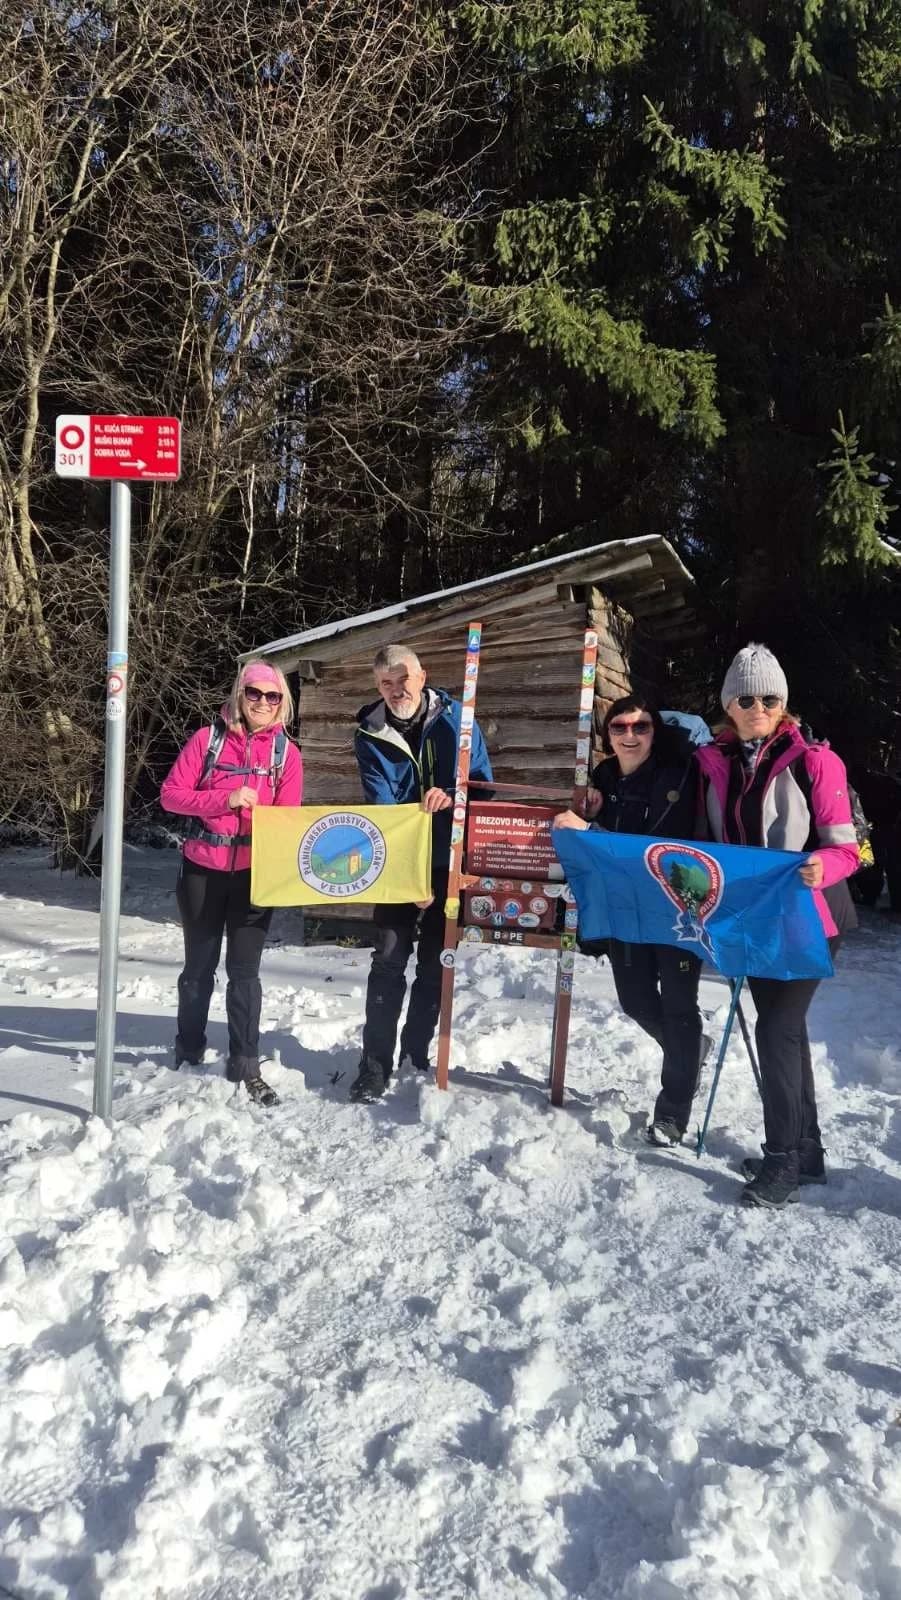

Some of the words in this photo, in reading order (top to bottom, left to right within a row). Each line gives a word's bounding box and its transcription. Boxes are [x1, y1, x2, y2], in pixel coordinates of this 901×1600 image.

[94, 448, 114, 457] DOBRA
[115, 449, 131, 457] VODA
[59, 453, 84, 466] 301
[475, 816, 511, 826] BREZOVO
[512, 818, 537, 828] POLJE
[302, 822, 328, 876] PLANINARSKO
[328, 815, 367, 829] DRUŠTVO
[320, 878, 369, 894] VELIKA
